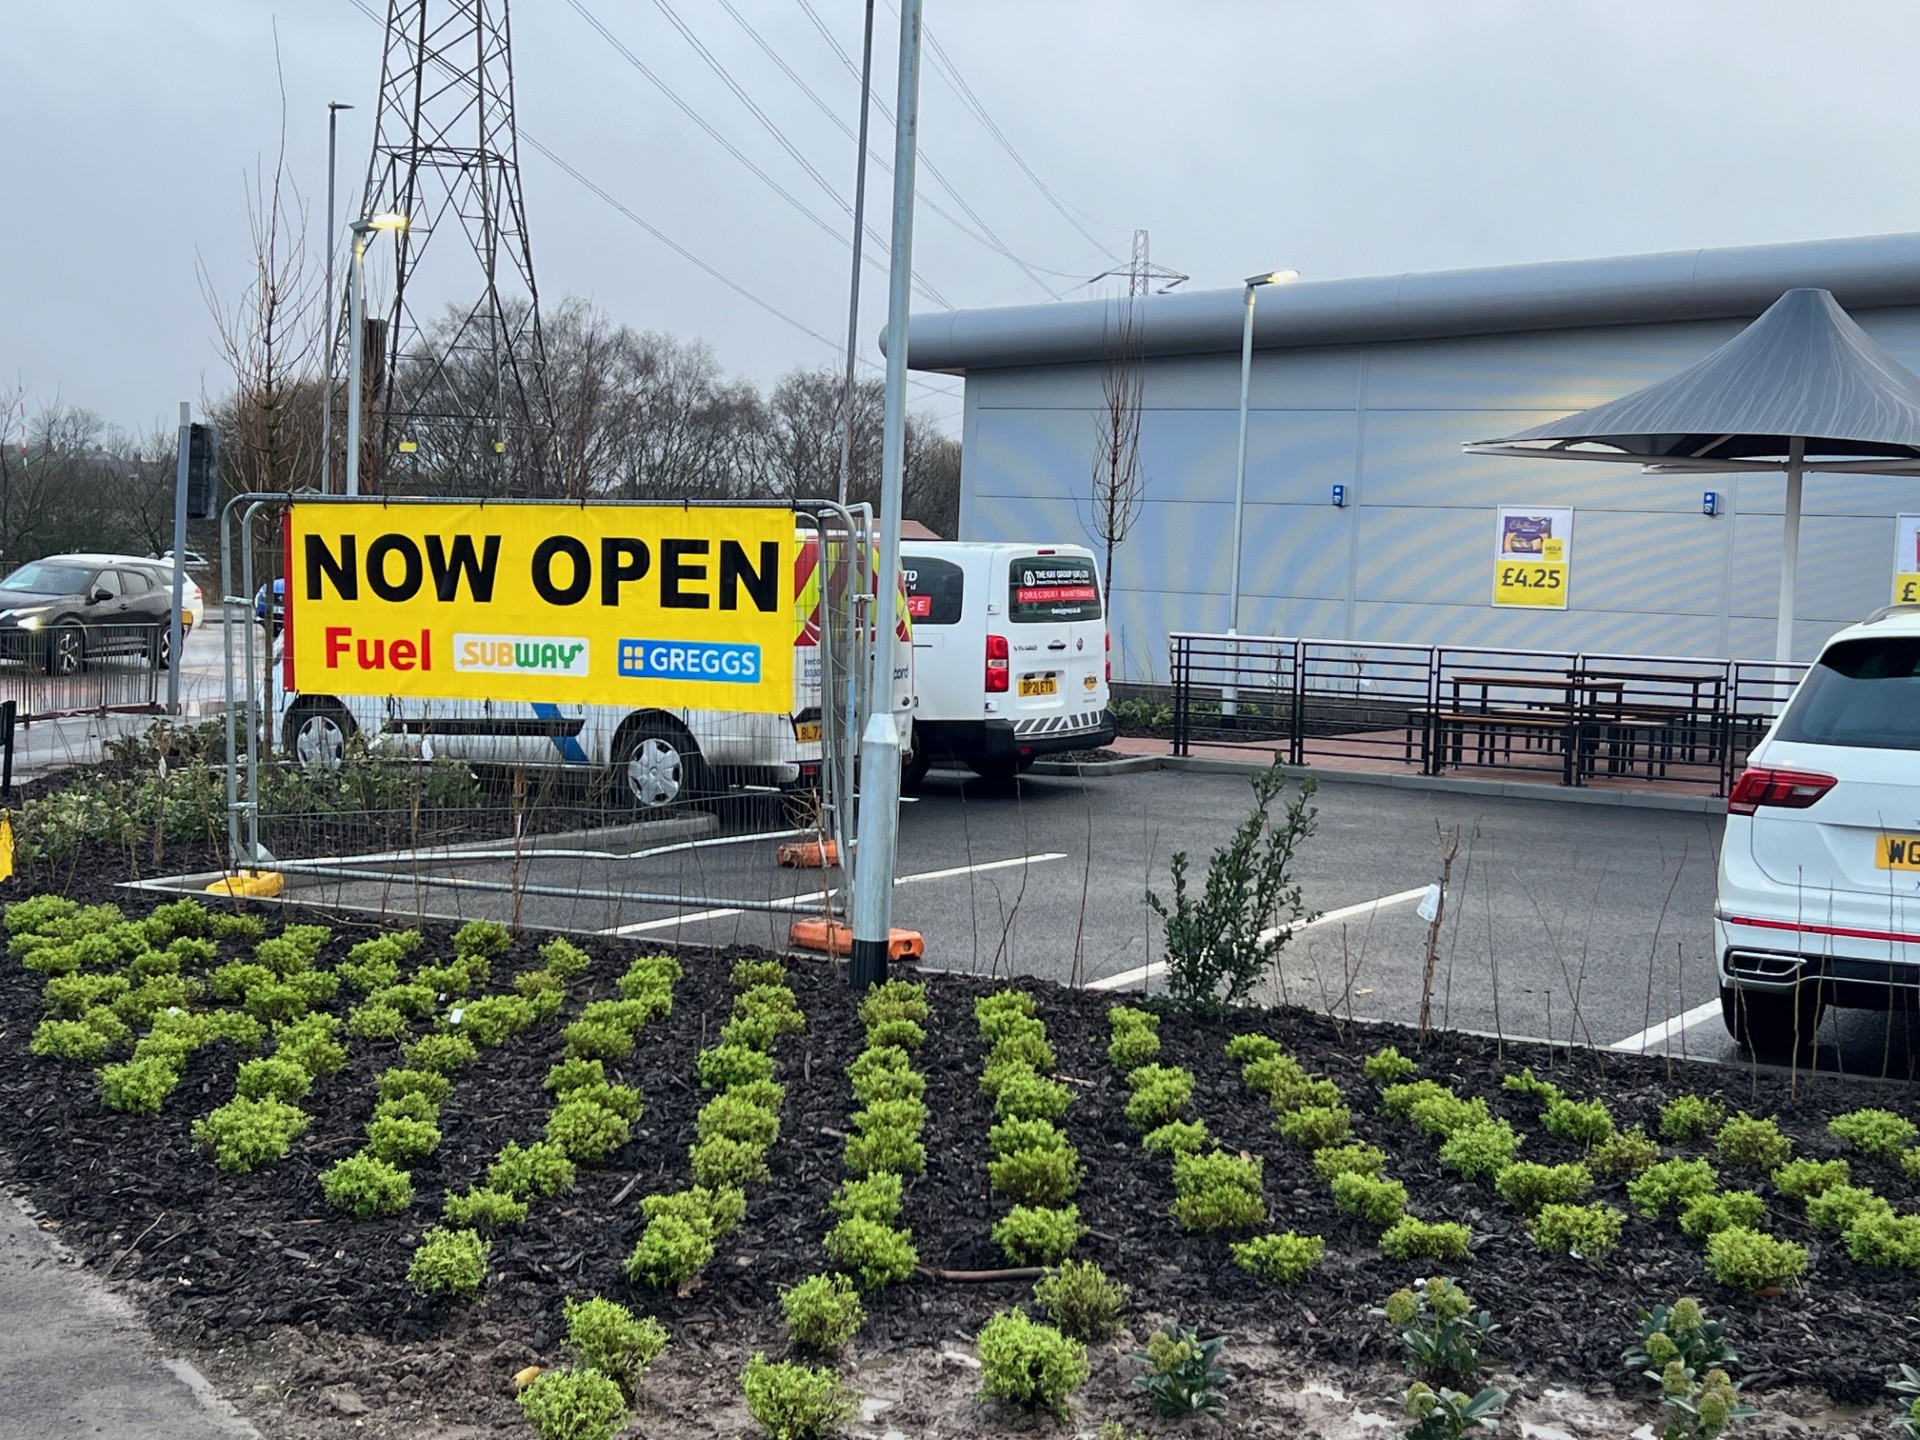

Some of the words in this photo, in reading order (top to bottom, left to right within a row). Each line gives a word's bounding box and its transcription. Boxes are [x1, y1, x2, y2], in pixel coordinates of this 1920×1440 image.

[304, 533, 501, 602] NOW
[531, 535, 779, 612] OPEN
[1502, 568, 1561, 589] £4.25
[325, 627, 431, 671] Fuel
[459, 641, 584, 669] SUBWAY
[650, 647, 756, 675] GREGGS
